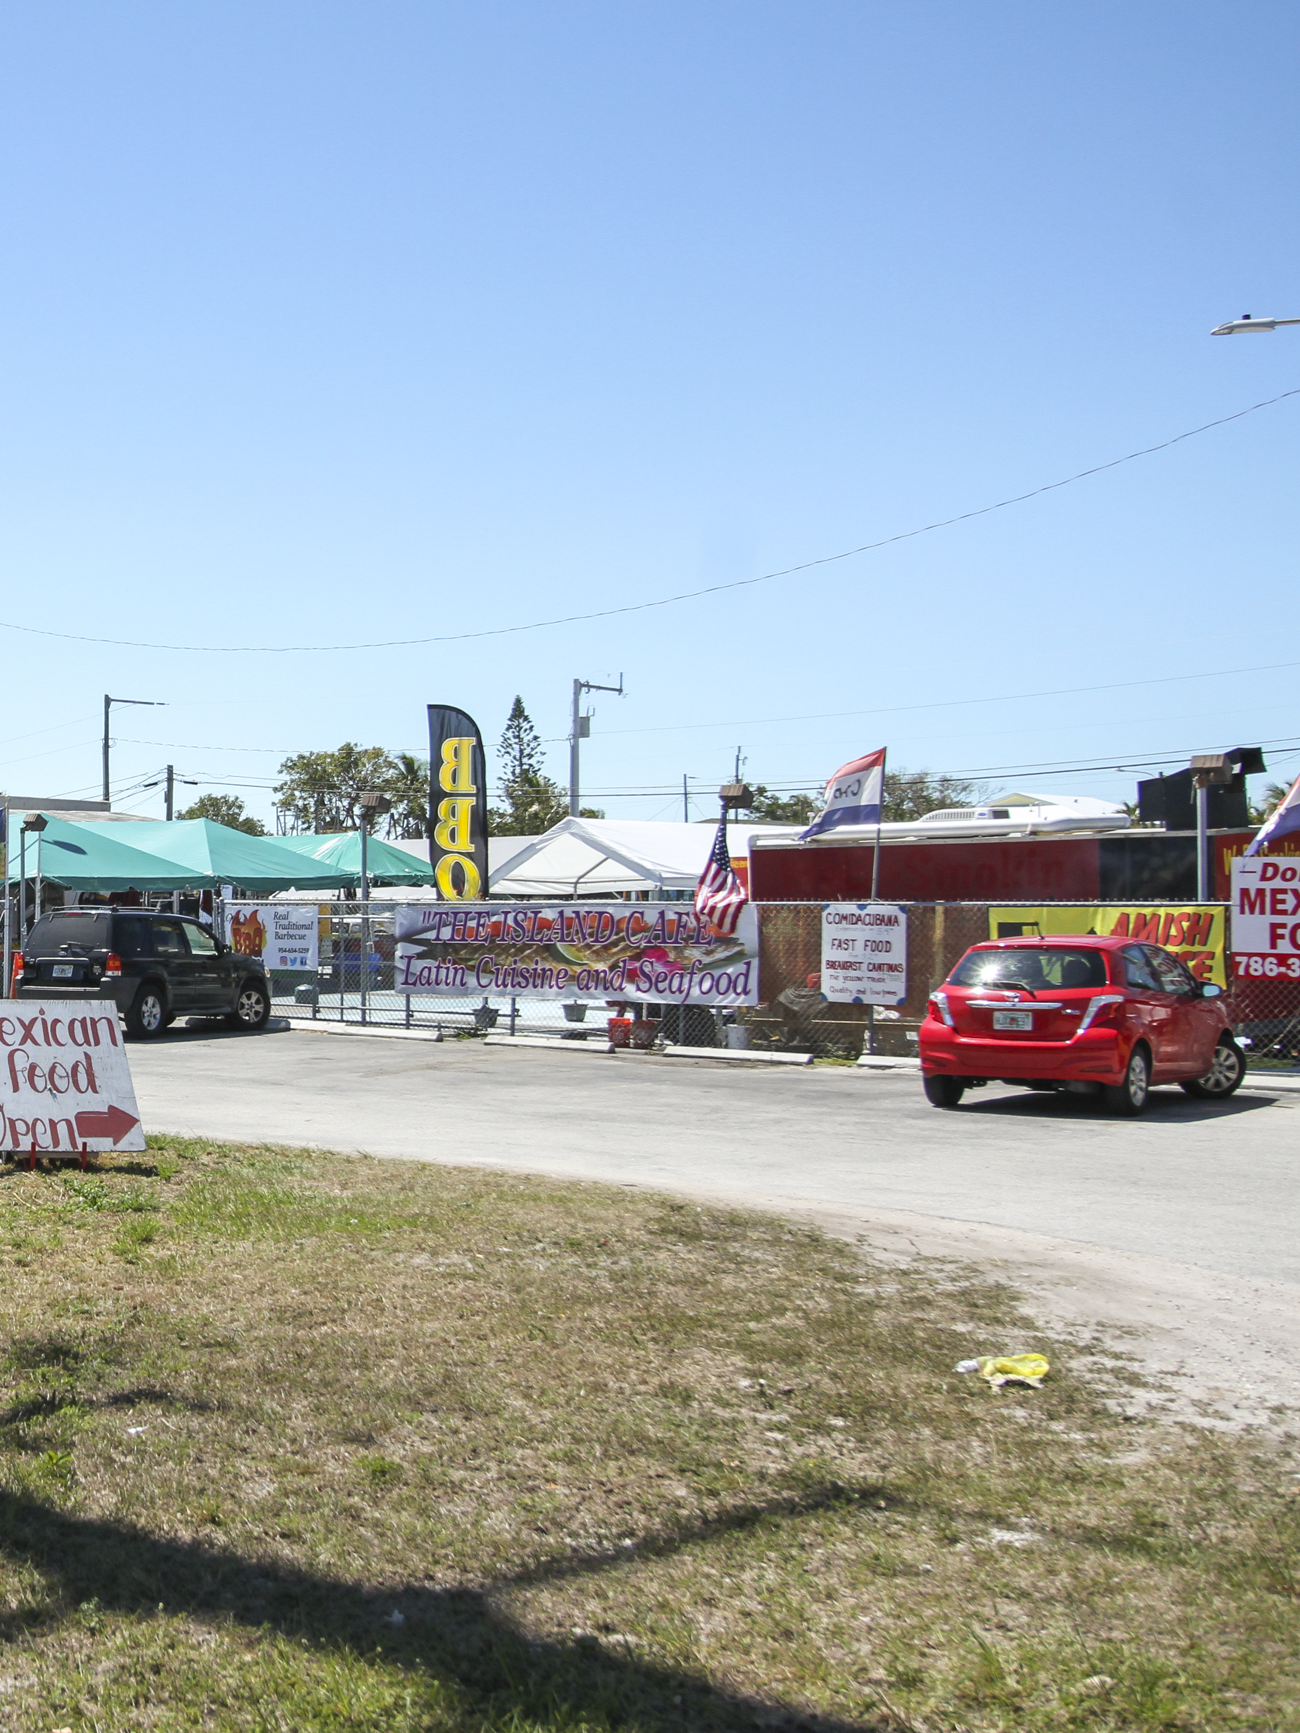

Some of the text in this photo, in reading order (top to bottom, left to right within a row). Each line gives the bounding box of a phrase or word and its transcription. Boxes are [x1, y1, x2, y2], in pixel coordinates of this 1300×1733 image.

[273, 911, 289, 920] Real
[274, 921, 314, 930] Traditional
[422, 909, 491, 945] "THE
[497, 909, 615, 945] ISLAND
[1110, 912, 1213, 946] AMISH
[274, 931, 307, 940] Barbecue
[831, 938, 892, 953] FAST FOOD
[401, 955, 752, 1004] Latin Cuisine and Seafood
